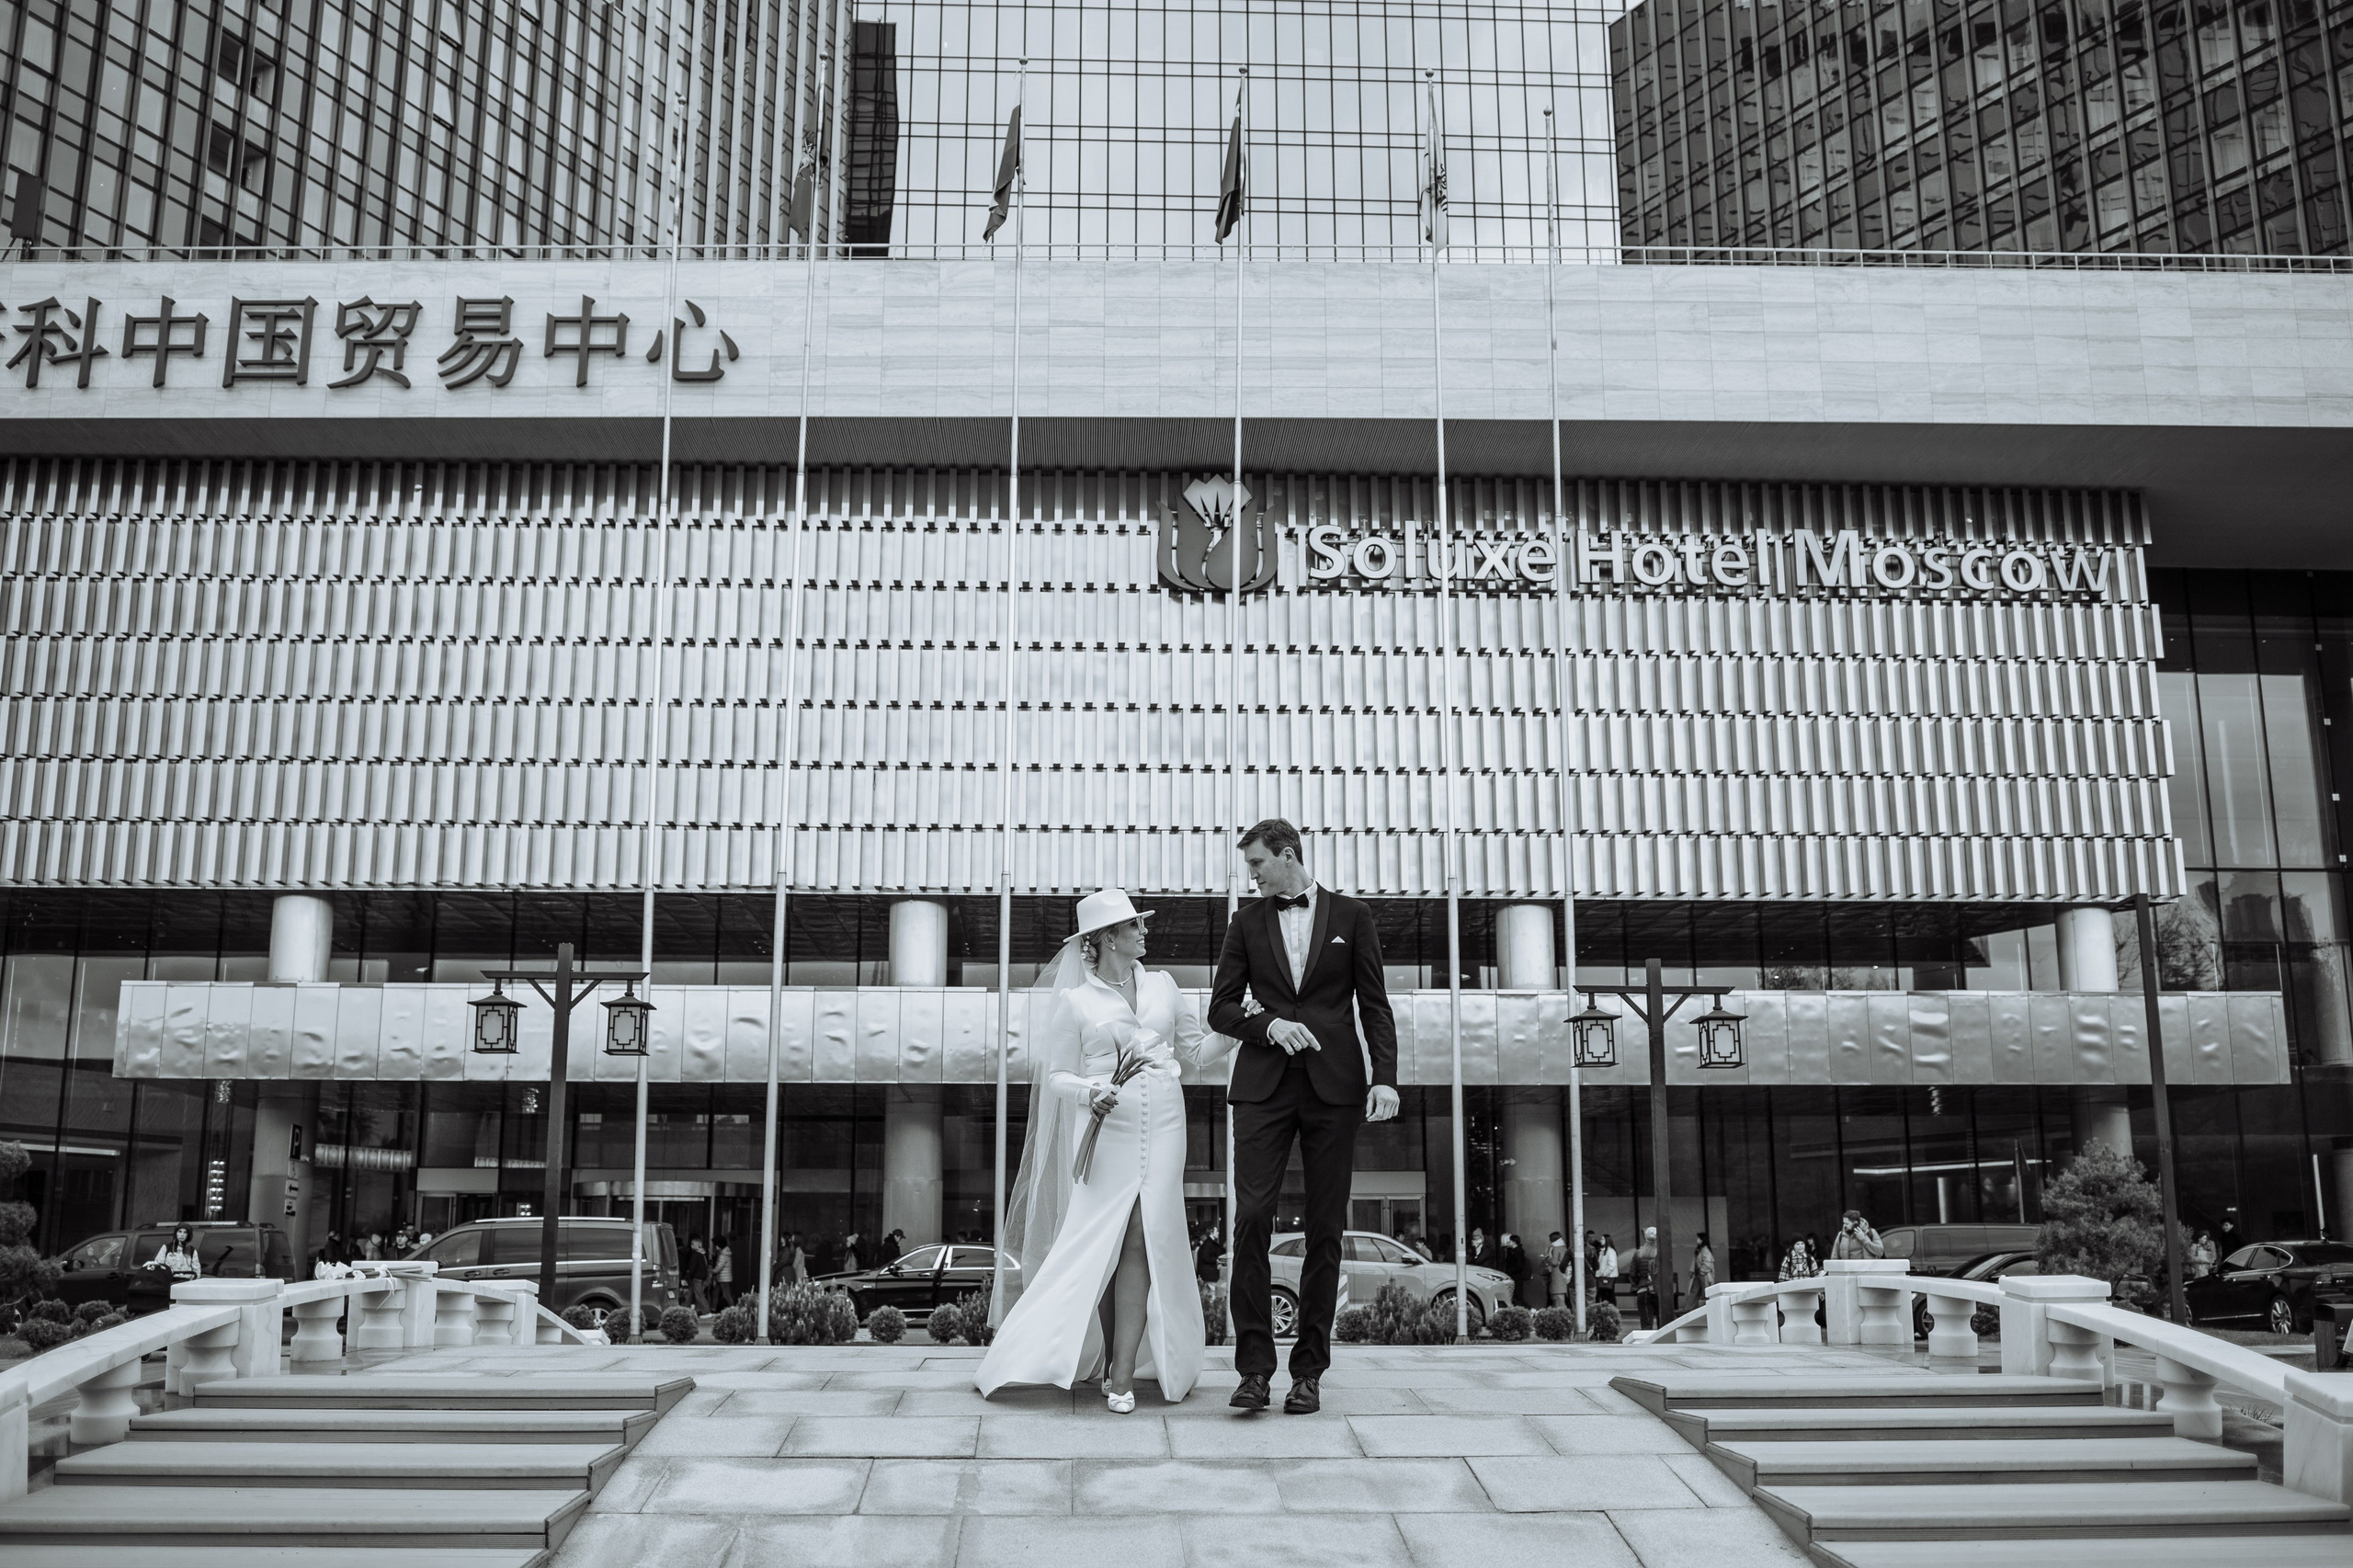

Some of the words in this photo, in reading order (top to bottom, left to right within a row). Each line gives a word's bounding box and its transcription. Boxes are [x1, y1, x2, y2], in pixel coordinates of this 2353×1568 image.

[0, 294, 739, 389] 科中国贸易中心
[1308, 520, 1557, 583] Soluxe
[1576, 528, 1771, 586] Hotel
[1792, 528, 2112, 593] Moscow
